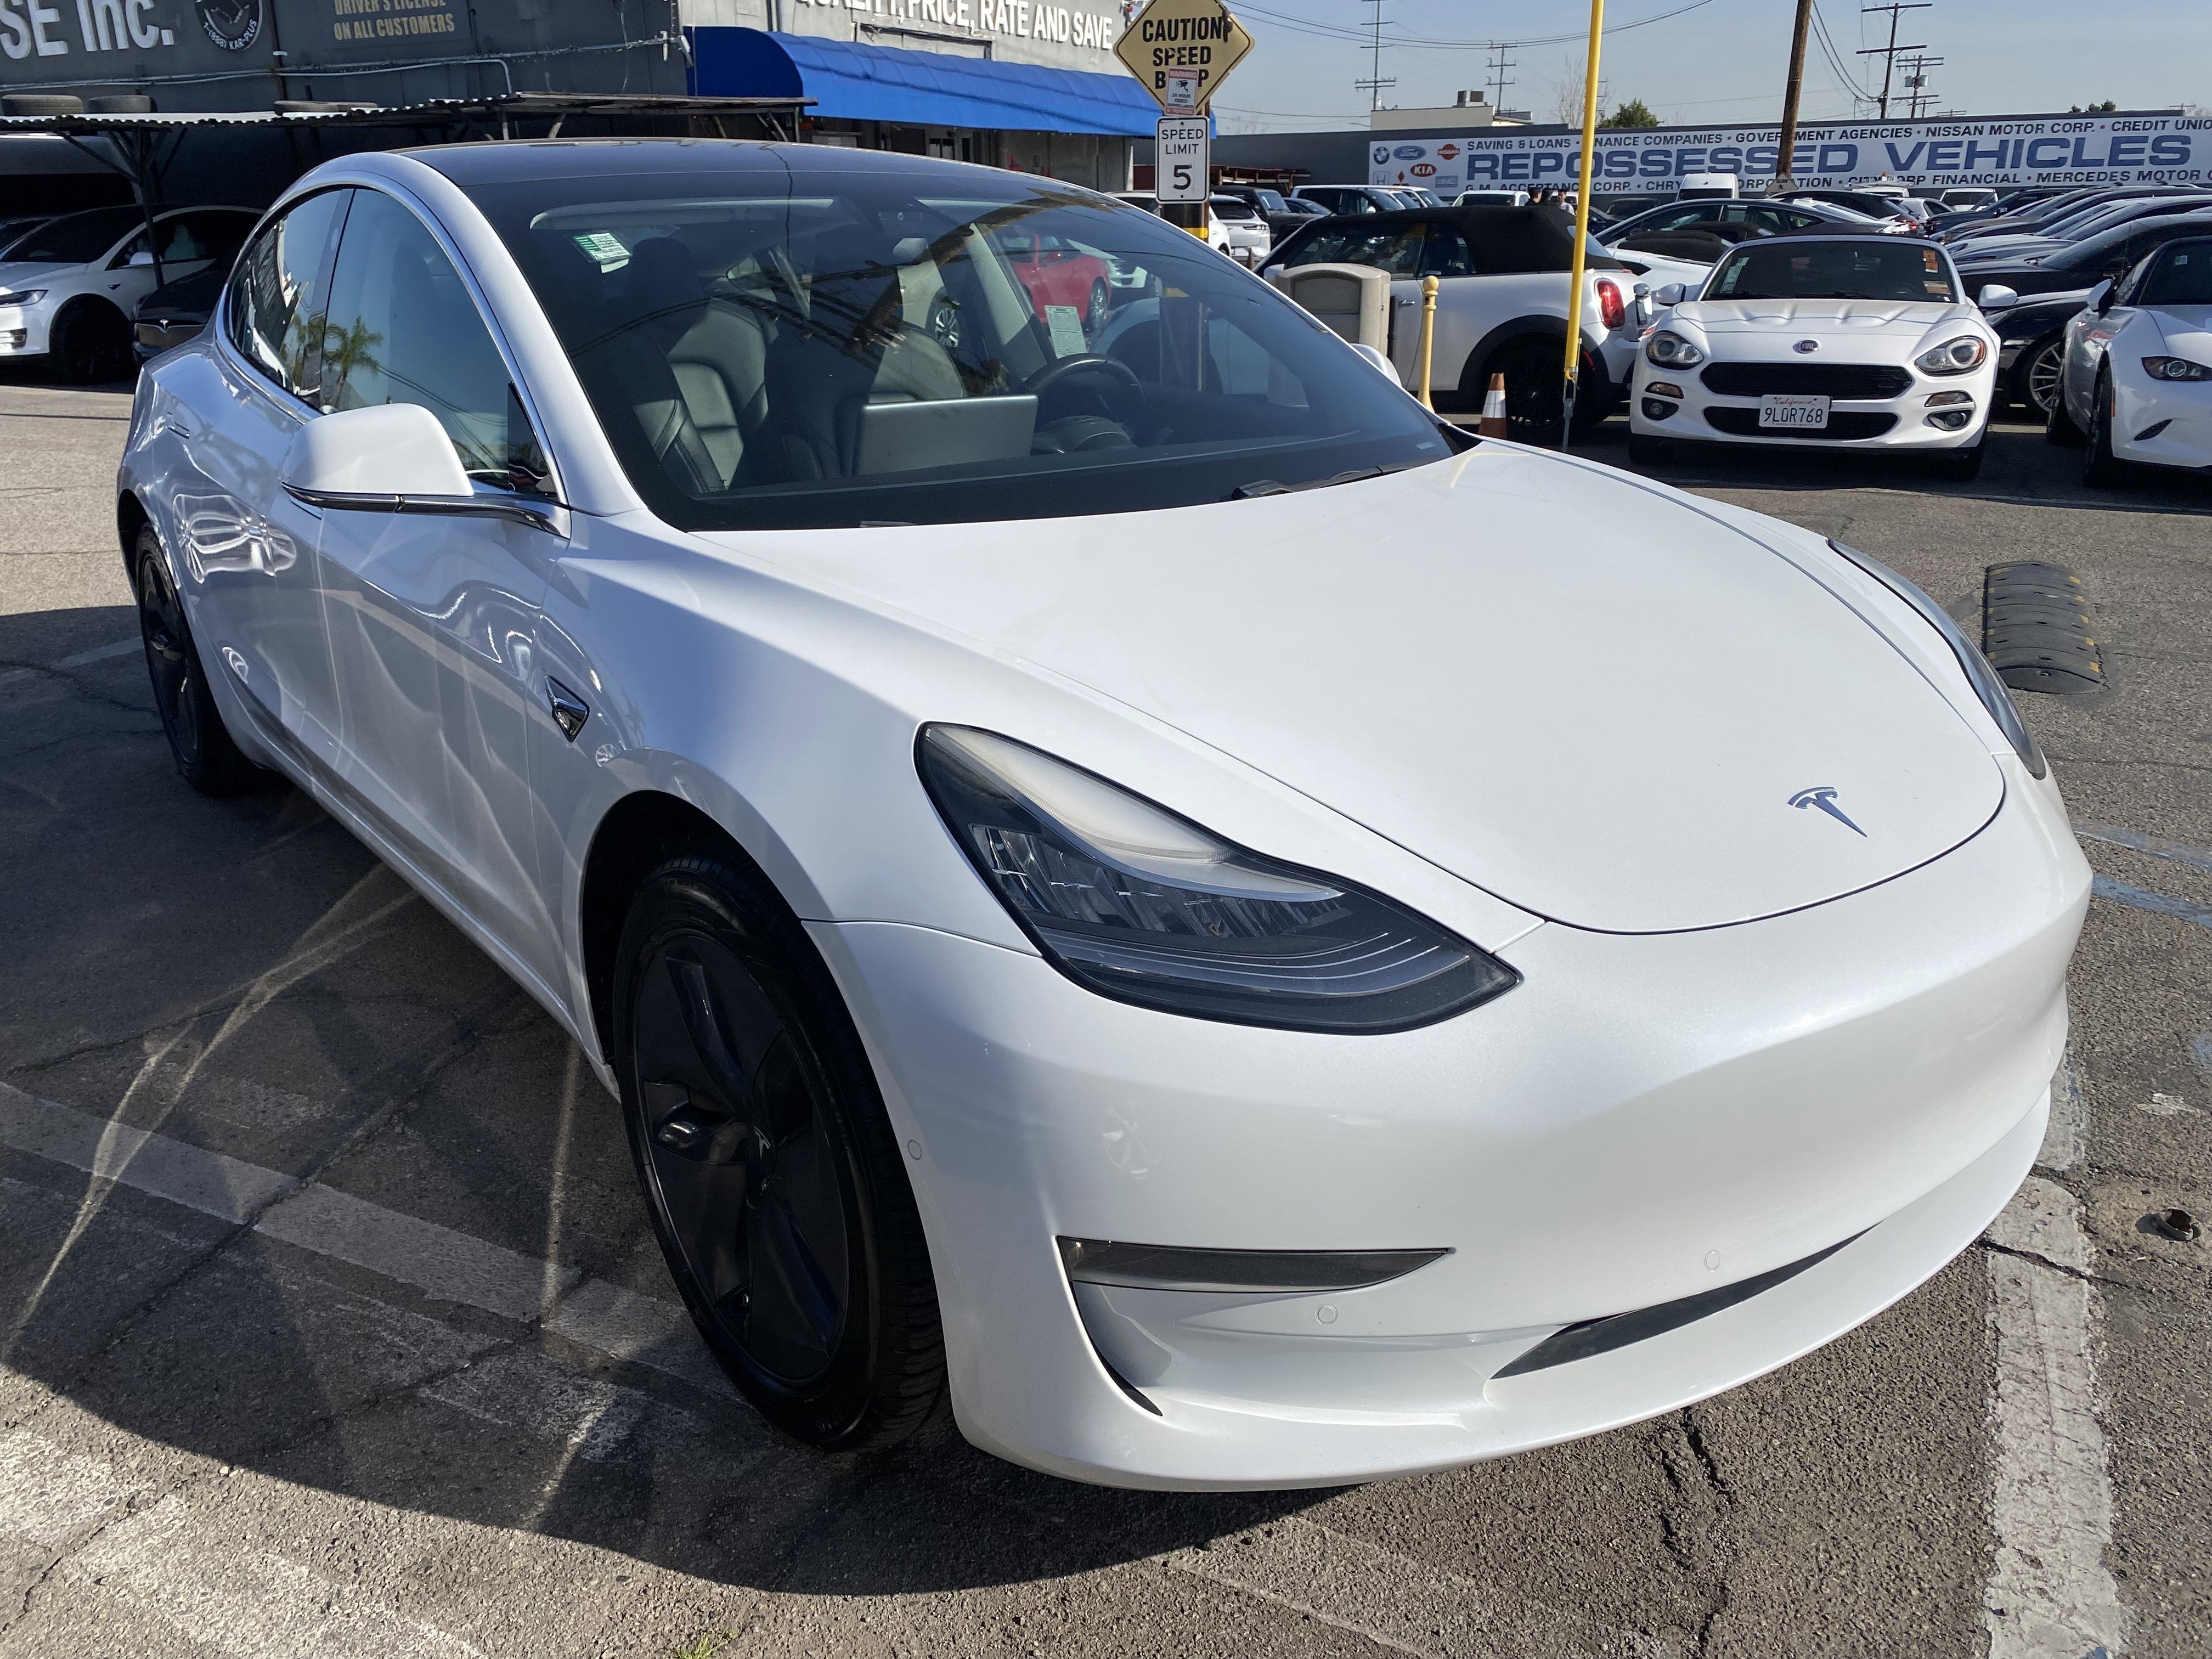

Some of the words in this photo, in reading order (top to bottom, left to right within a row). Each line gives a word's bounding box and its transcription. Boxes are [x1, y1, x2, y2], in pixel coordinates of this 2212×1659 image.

[334, 0, 391, 15] DRIVERS
[229, 19, 256, 50] KAR-PLUS
[334, 22, 352, 40] ON
[354, 20, 375, 39] ALL
[376, 13, 455, 37] CUSTOMERS
[981, 0, 1029, 36] RATE
[1034, 4, 1069, 42] AND
[1073, 11, 1113, 49] SAVE
[1142, 16, 1222, 42] CAUTION
[1153, 46, 1212, 67] SPEED
[1155, 69, 1209, 89] BP
[1161, 129, 1204, 140] SPEED
[1467, 140, 1513, 150] SAVING
[1518, 140, 1526, 149] &
[1529, 138, 1571, 149] LOANS
[1594, 136, 1640, 146] NANCE
[1644, 133, 1723, 145] COMPANIES
[1736, 129, 1835, 143] GOVEMENT
[1839, 127, 1913, 140] AGENCIES
[1926, 125, 1985, 137] NISSAN
[1989, 123, 2045, 135] MOTOR
[2051, 122, 2096, 133] CORP.
[2112, 120, 2170, 132] CREDIT
[1165, 144, 1199, 155] LIMIT
[1467, 144, 1859, 181] REPOSSESSED
[1884, 134, 2192, 172] VEHICLES
[1173, 164, 1192, 190] 5
[1414, 166, 1434, 174] KIA
[1501, 182, 1579, 191] ACCEPTANC
[1594, 182, 1632, 191] CORP.
[1646, 180, 1682, 191] CHRY
[1932, 173, 2021, 185] FINANCIAL
[2036, 171, 2131, 183] MERCEDES
[2137, 170, 2201, 182] MOTOR
[1775, 397, 1813, 407] California
